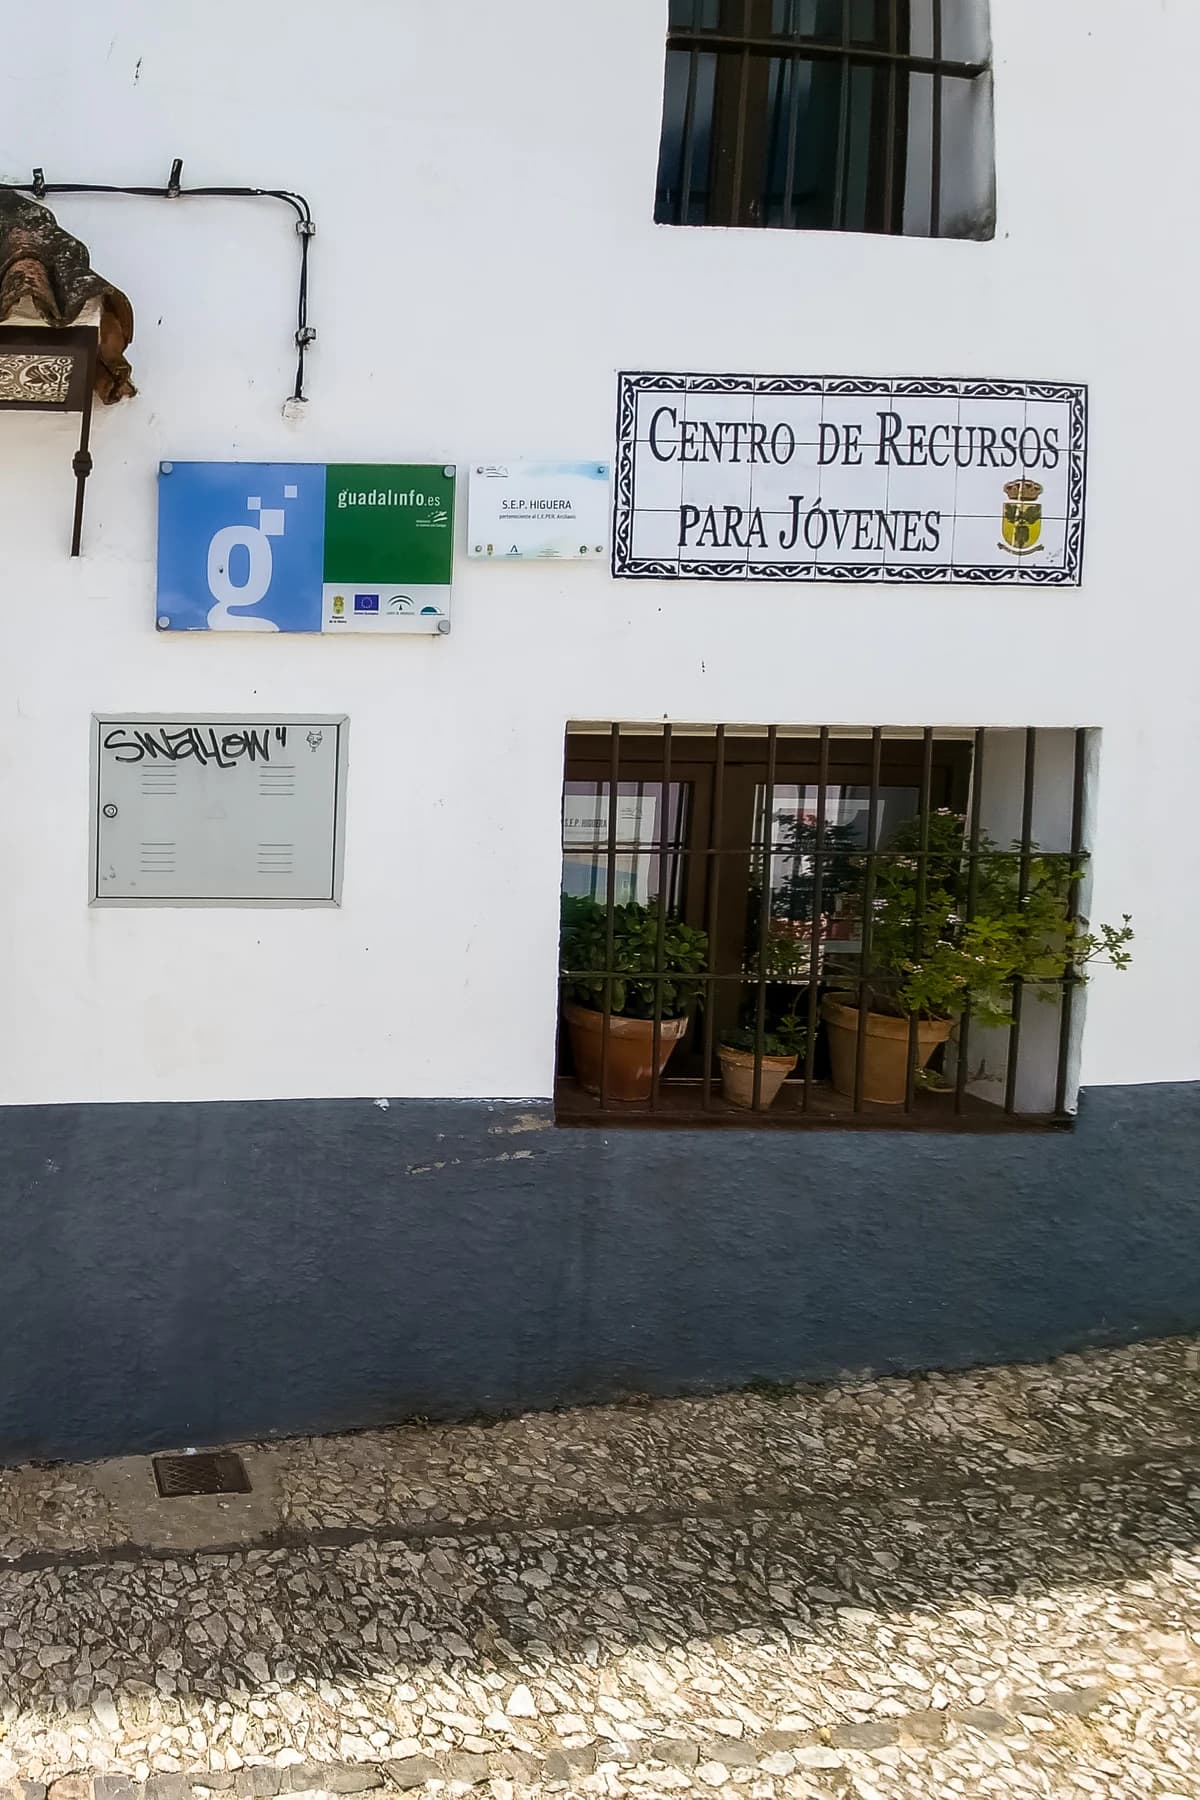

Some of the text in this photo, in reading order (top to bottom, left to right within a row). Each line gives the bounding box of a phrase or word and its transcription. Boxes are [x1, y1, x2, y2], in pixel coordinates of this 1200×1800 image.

[649, 407, 1059, 469] CENTRO DE RECURSOS
[502, 500, 572, 510] S.E.P. HIGUERA
[678, 495, 941, 552] PARA JÓVENES
